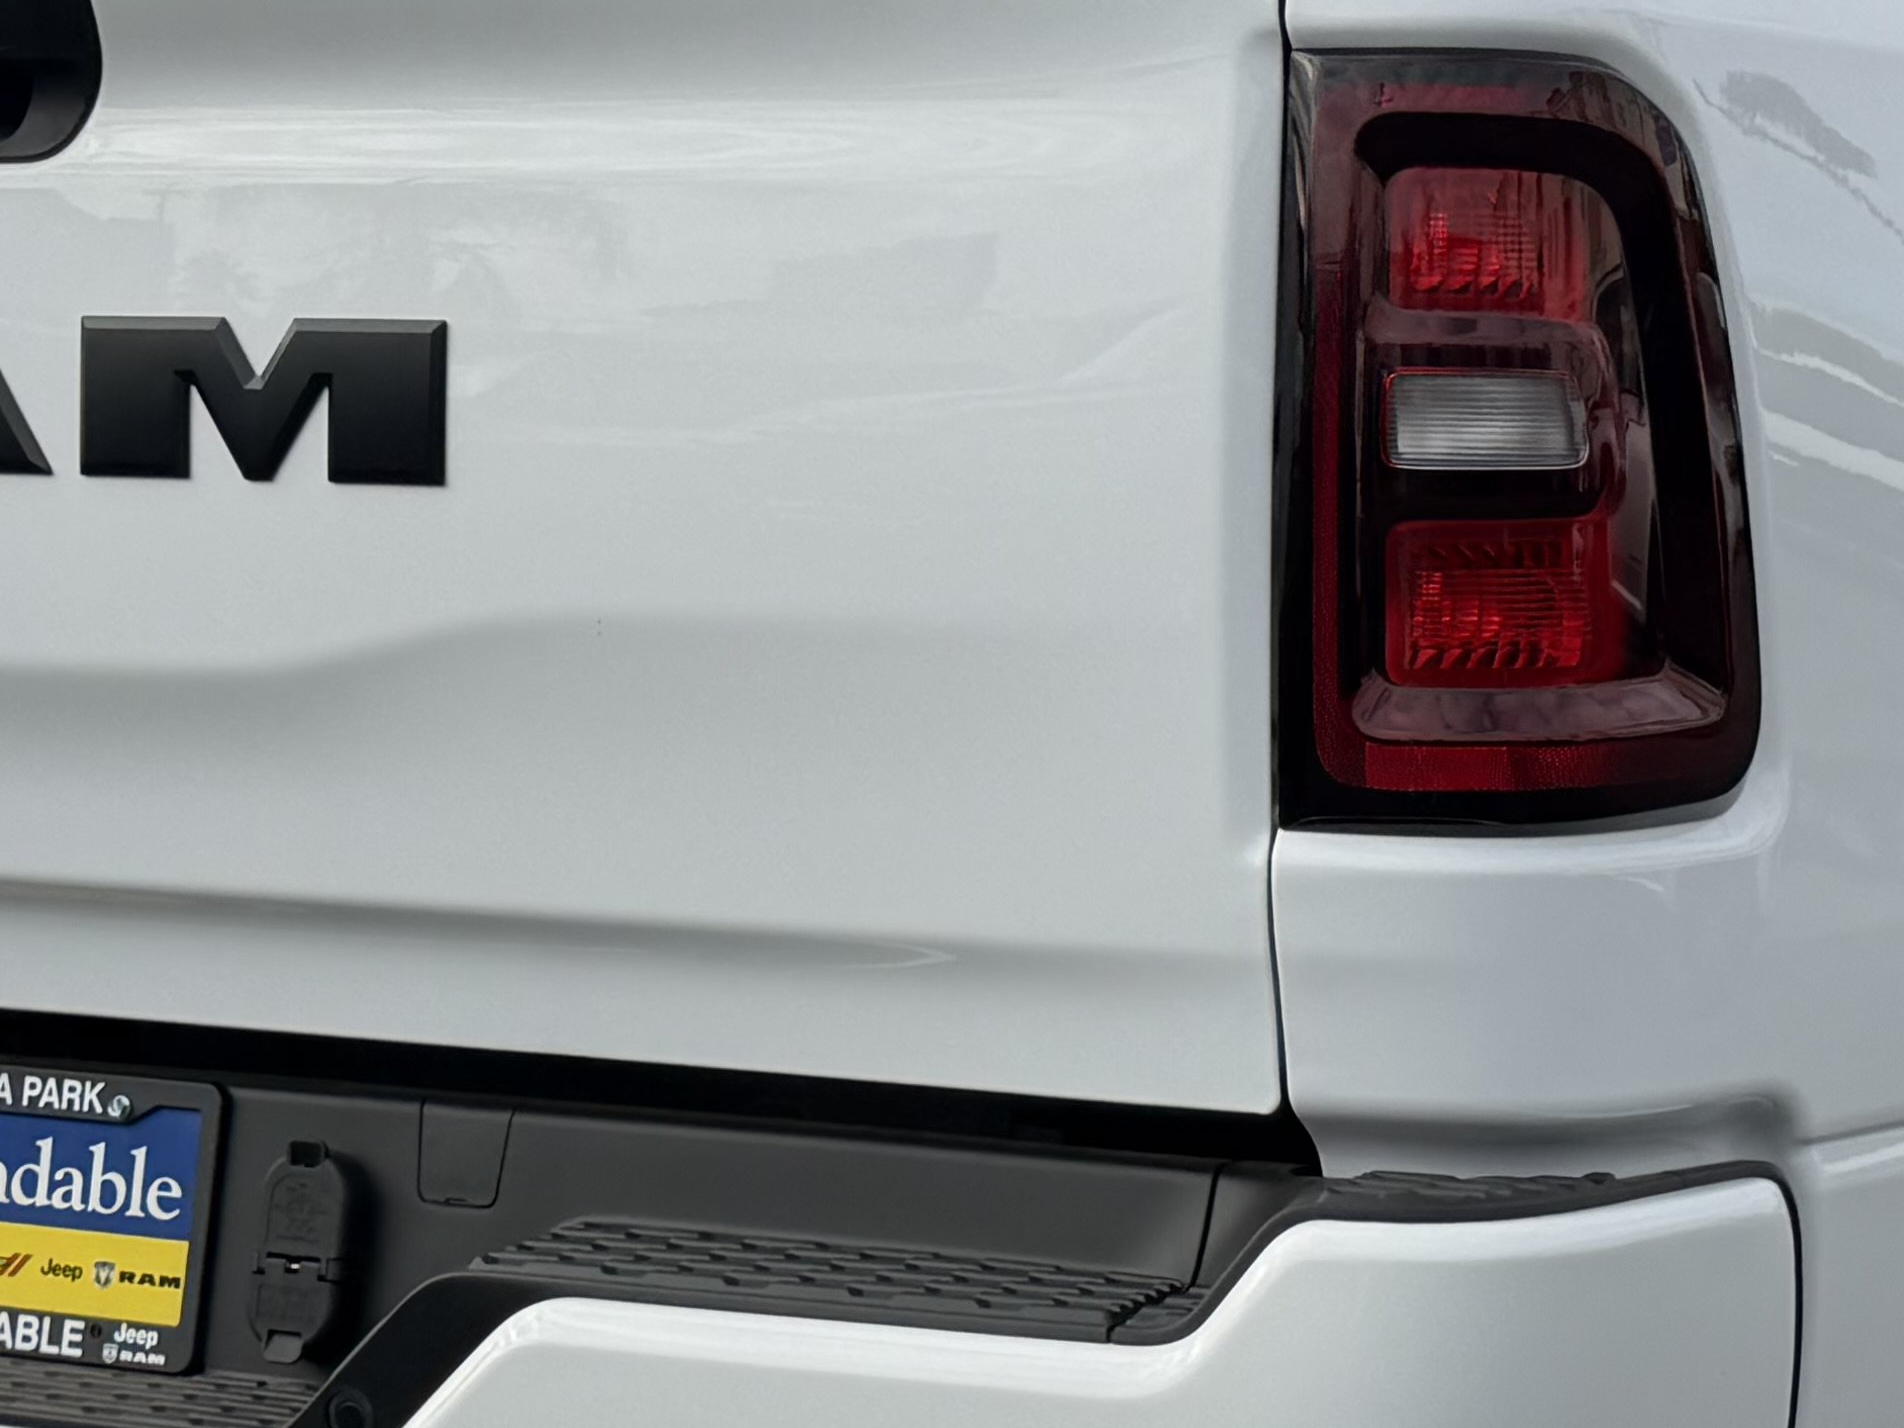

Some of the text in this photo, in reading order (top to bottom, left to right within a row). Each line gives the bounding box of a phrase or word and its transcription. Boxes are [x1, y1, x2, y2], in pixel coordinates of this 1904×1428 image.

[22, 1075, 106, 1114] PARK
[40, 1258, 83, 1282] Jeep
[119, 1270, 181, 1289] RAM
[113, 1322, 159, 1349] Jeep
[119, 1349, 166, 1366] RAM
